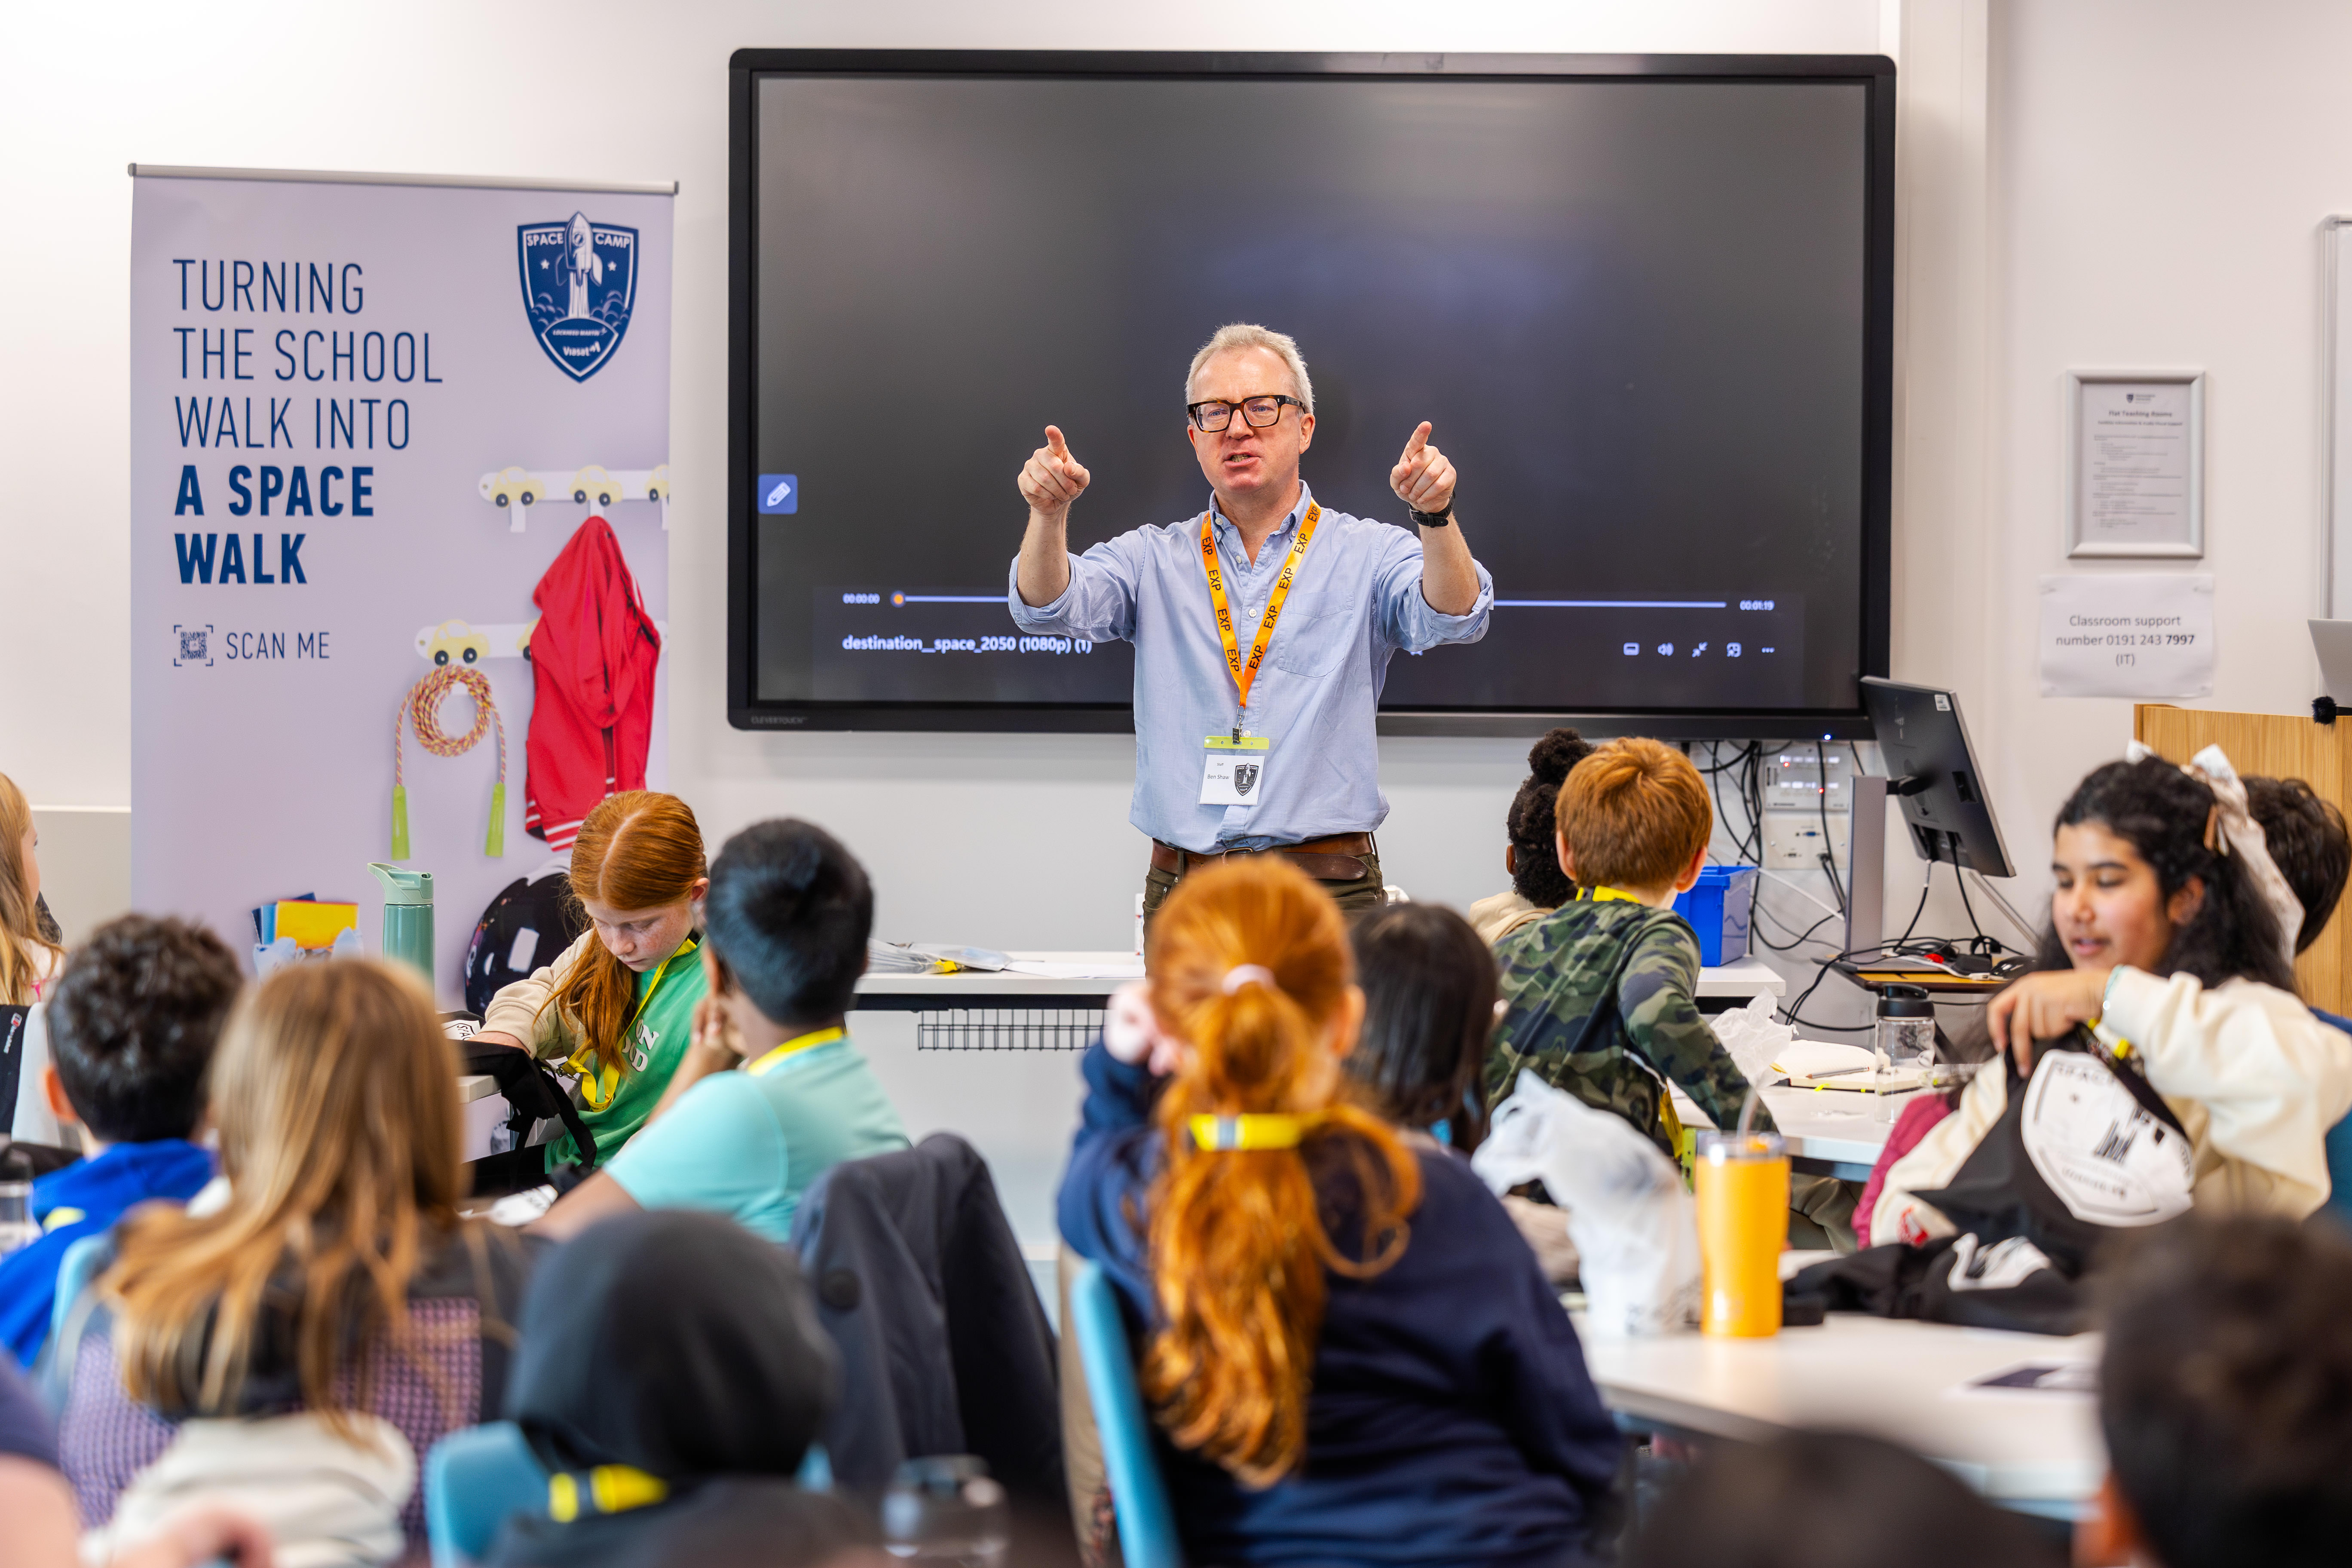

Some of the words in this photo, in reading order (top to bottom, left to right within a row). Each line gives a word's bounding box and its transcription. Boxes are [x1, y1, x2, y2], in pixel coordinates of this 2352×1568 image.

[527, 233, 564, 246] SPACE
[595, 233, 630, 248] CAMP
[173, 260, 364, 314] TURNING
[174, 328, 254, 380] THE
[275, 329, 443, 383] SCHOOL
[175, 397, 294, 449] WALK
[315, 398, 410, 450] INTO
[175, 465, 204, 516] A
[228, 465, 374, 516] SPACE
[1308, 506, 1319, 522] EXP
[1202, 536, 1213, 555] EXP
[1294, 533, 1308, 554] EXP
[175, 533, 307, 584] WALK
[1209, 570, 1221, 591] EXP
[1278, 568, 1293, 589] EXP
[1217, 609, 1231, 631] EXP
[1263, 605, 1278, 629] EXP
[2070, 615, 2131, 626] Classroom
[2135, 616, 2181, 628] support
[226, 632, 285, 659] SCAN
[298, 632, 330, 658] ME
[1019, 636, 1072, 655] (1080p)
[1075, 639, 1092, 654] (1)
[2056, 635, 2103, 645] number
[2107, 635, 2135, 645] 0191
[2140, 635, 2161, 645] 243
[2166, 635, 2195, 645] 7997
[1227, 649, 1239, 671] EXP
[1249, 645, 1263, 670] EXP
[2116, 654, 2135, 666] (IT)
